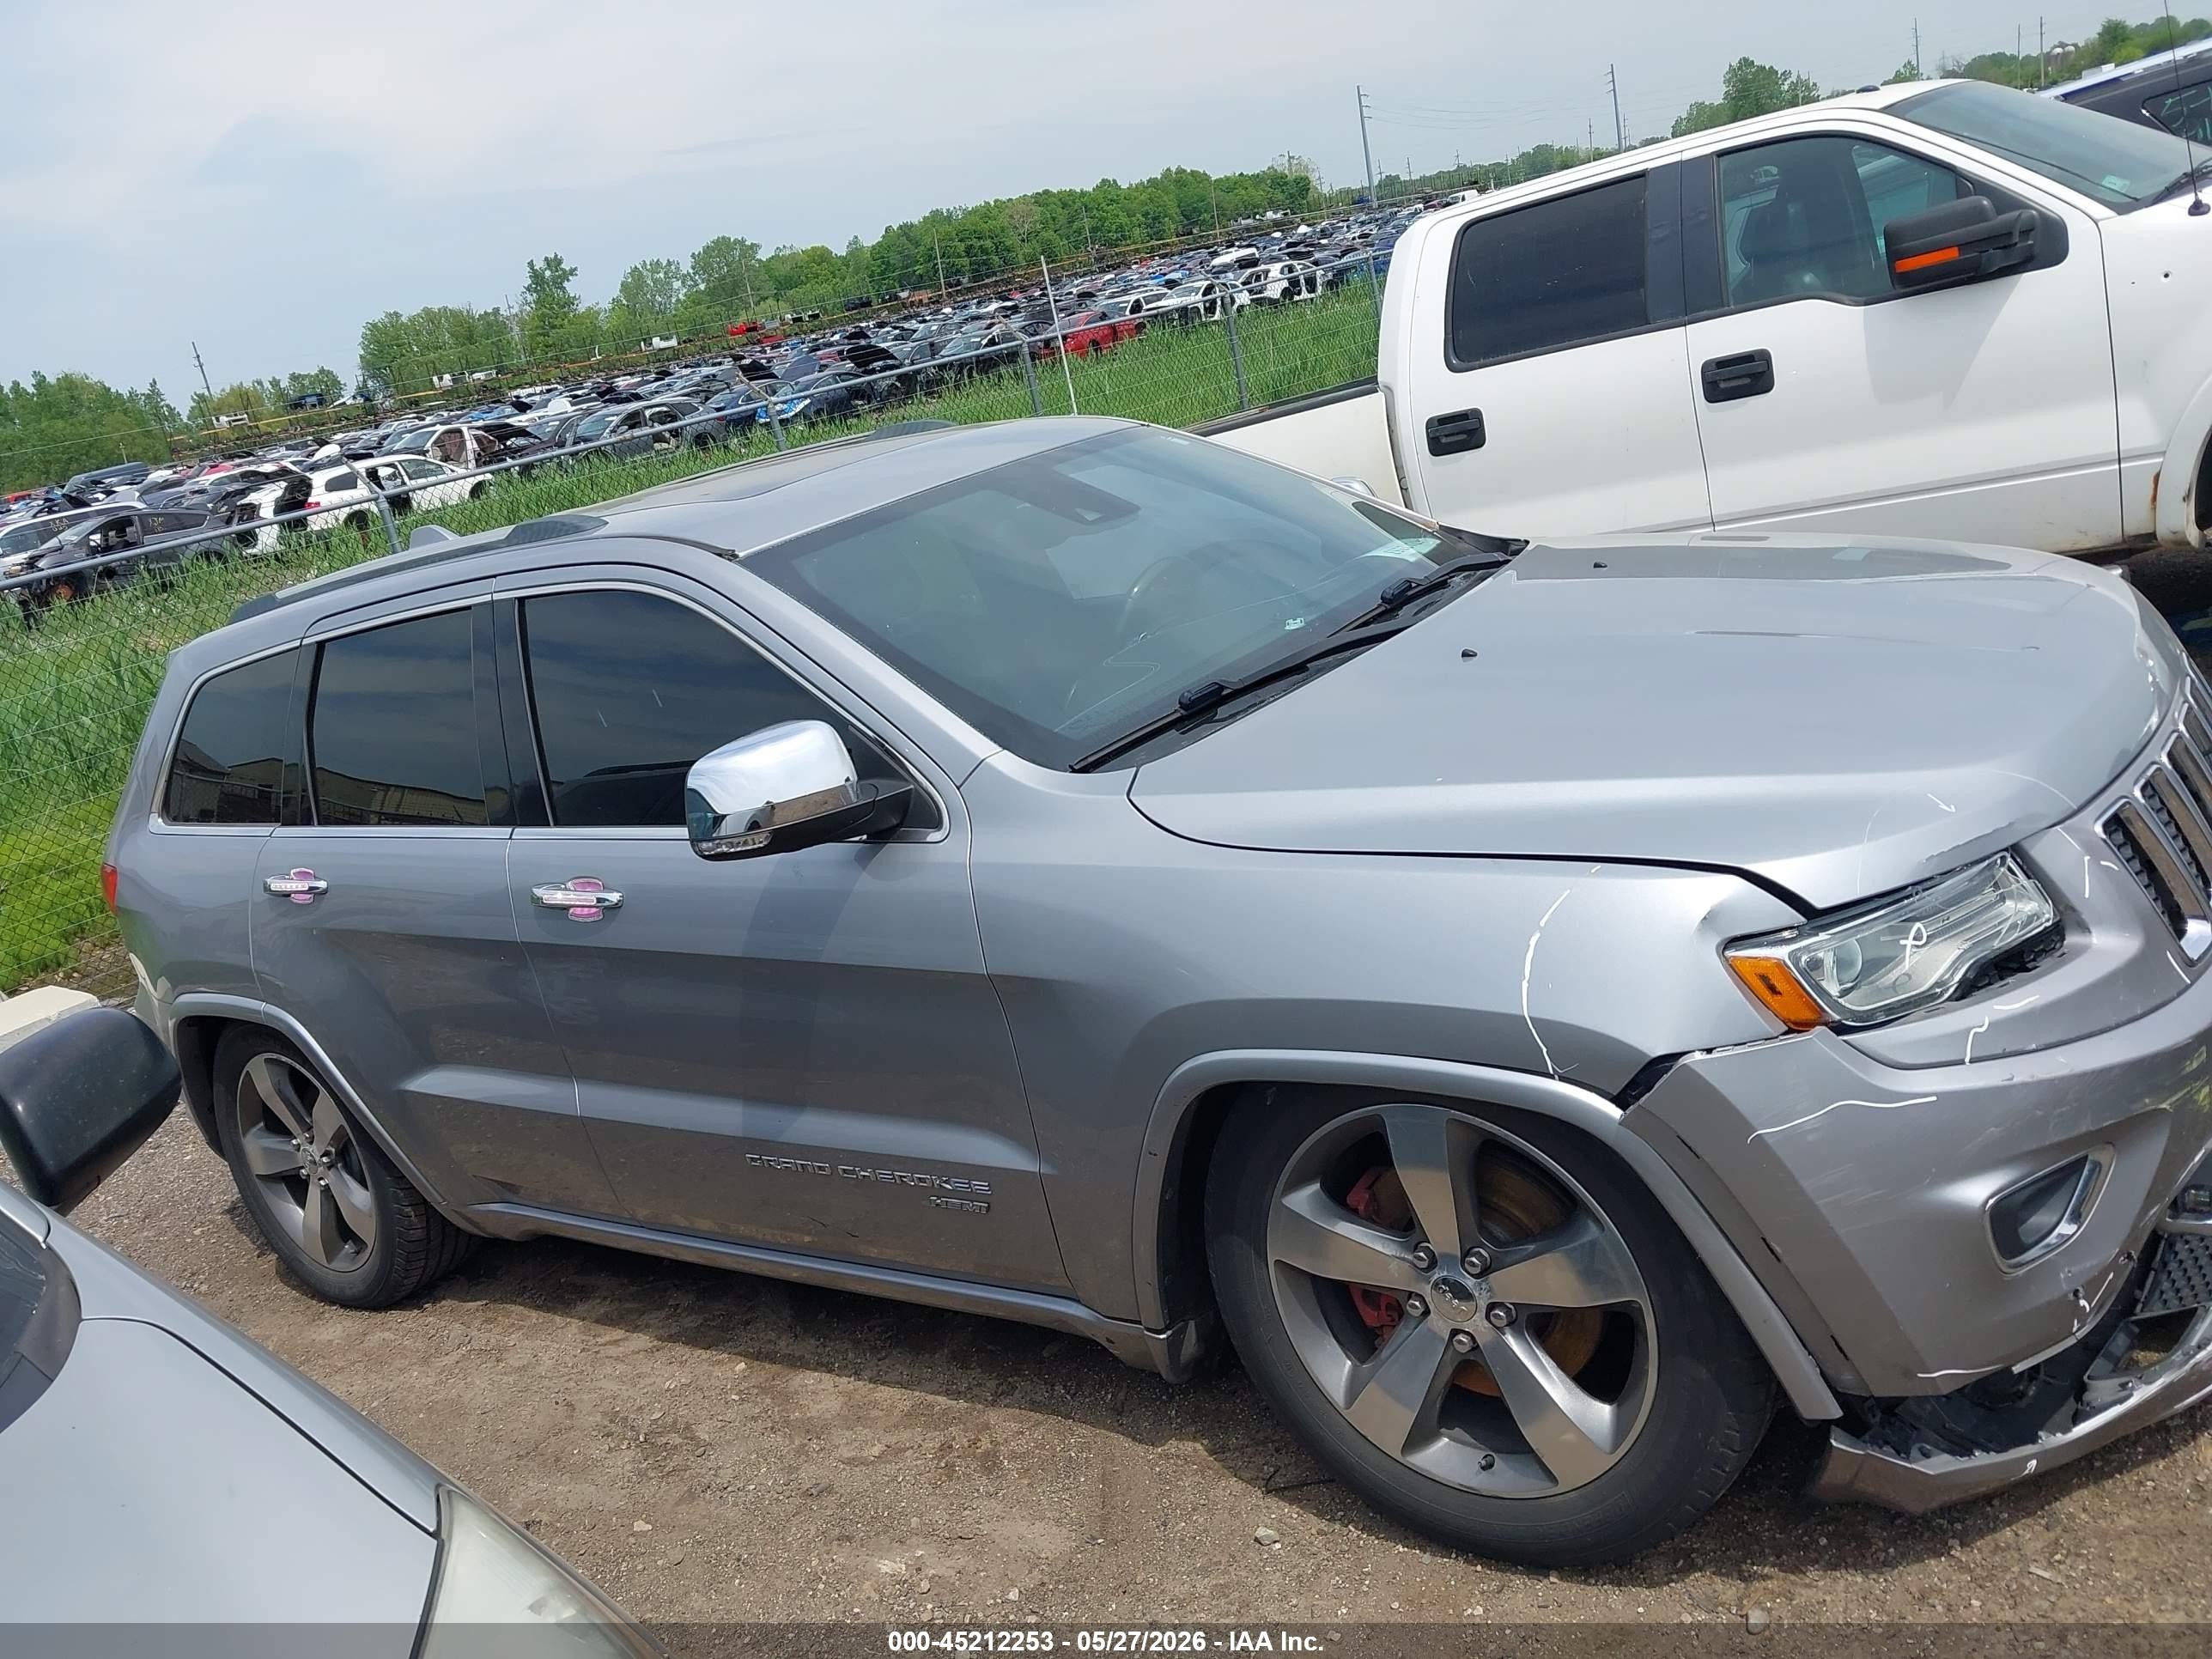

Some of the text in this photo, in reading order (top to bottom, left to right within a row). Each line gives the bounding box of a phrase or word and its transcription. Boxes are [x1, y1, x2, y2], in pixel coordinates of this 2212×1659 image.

[744, 1153, 992, 1194] GRAND CHEROKEE
[928, 1195, 990, 1213] HEMI
